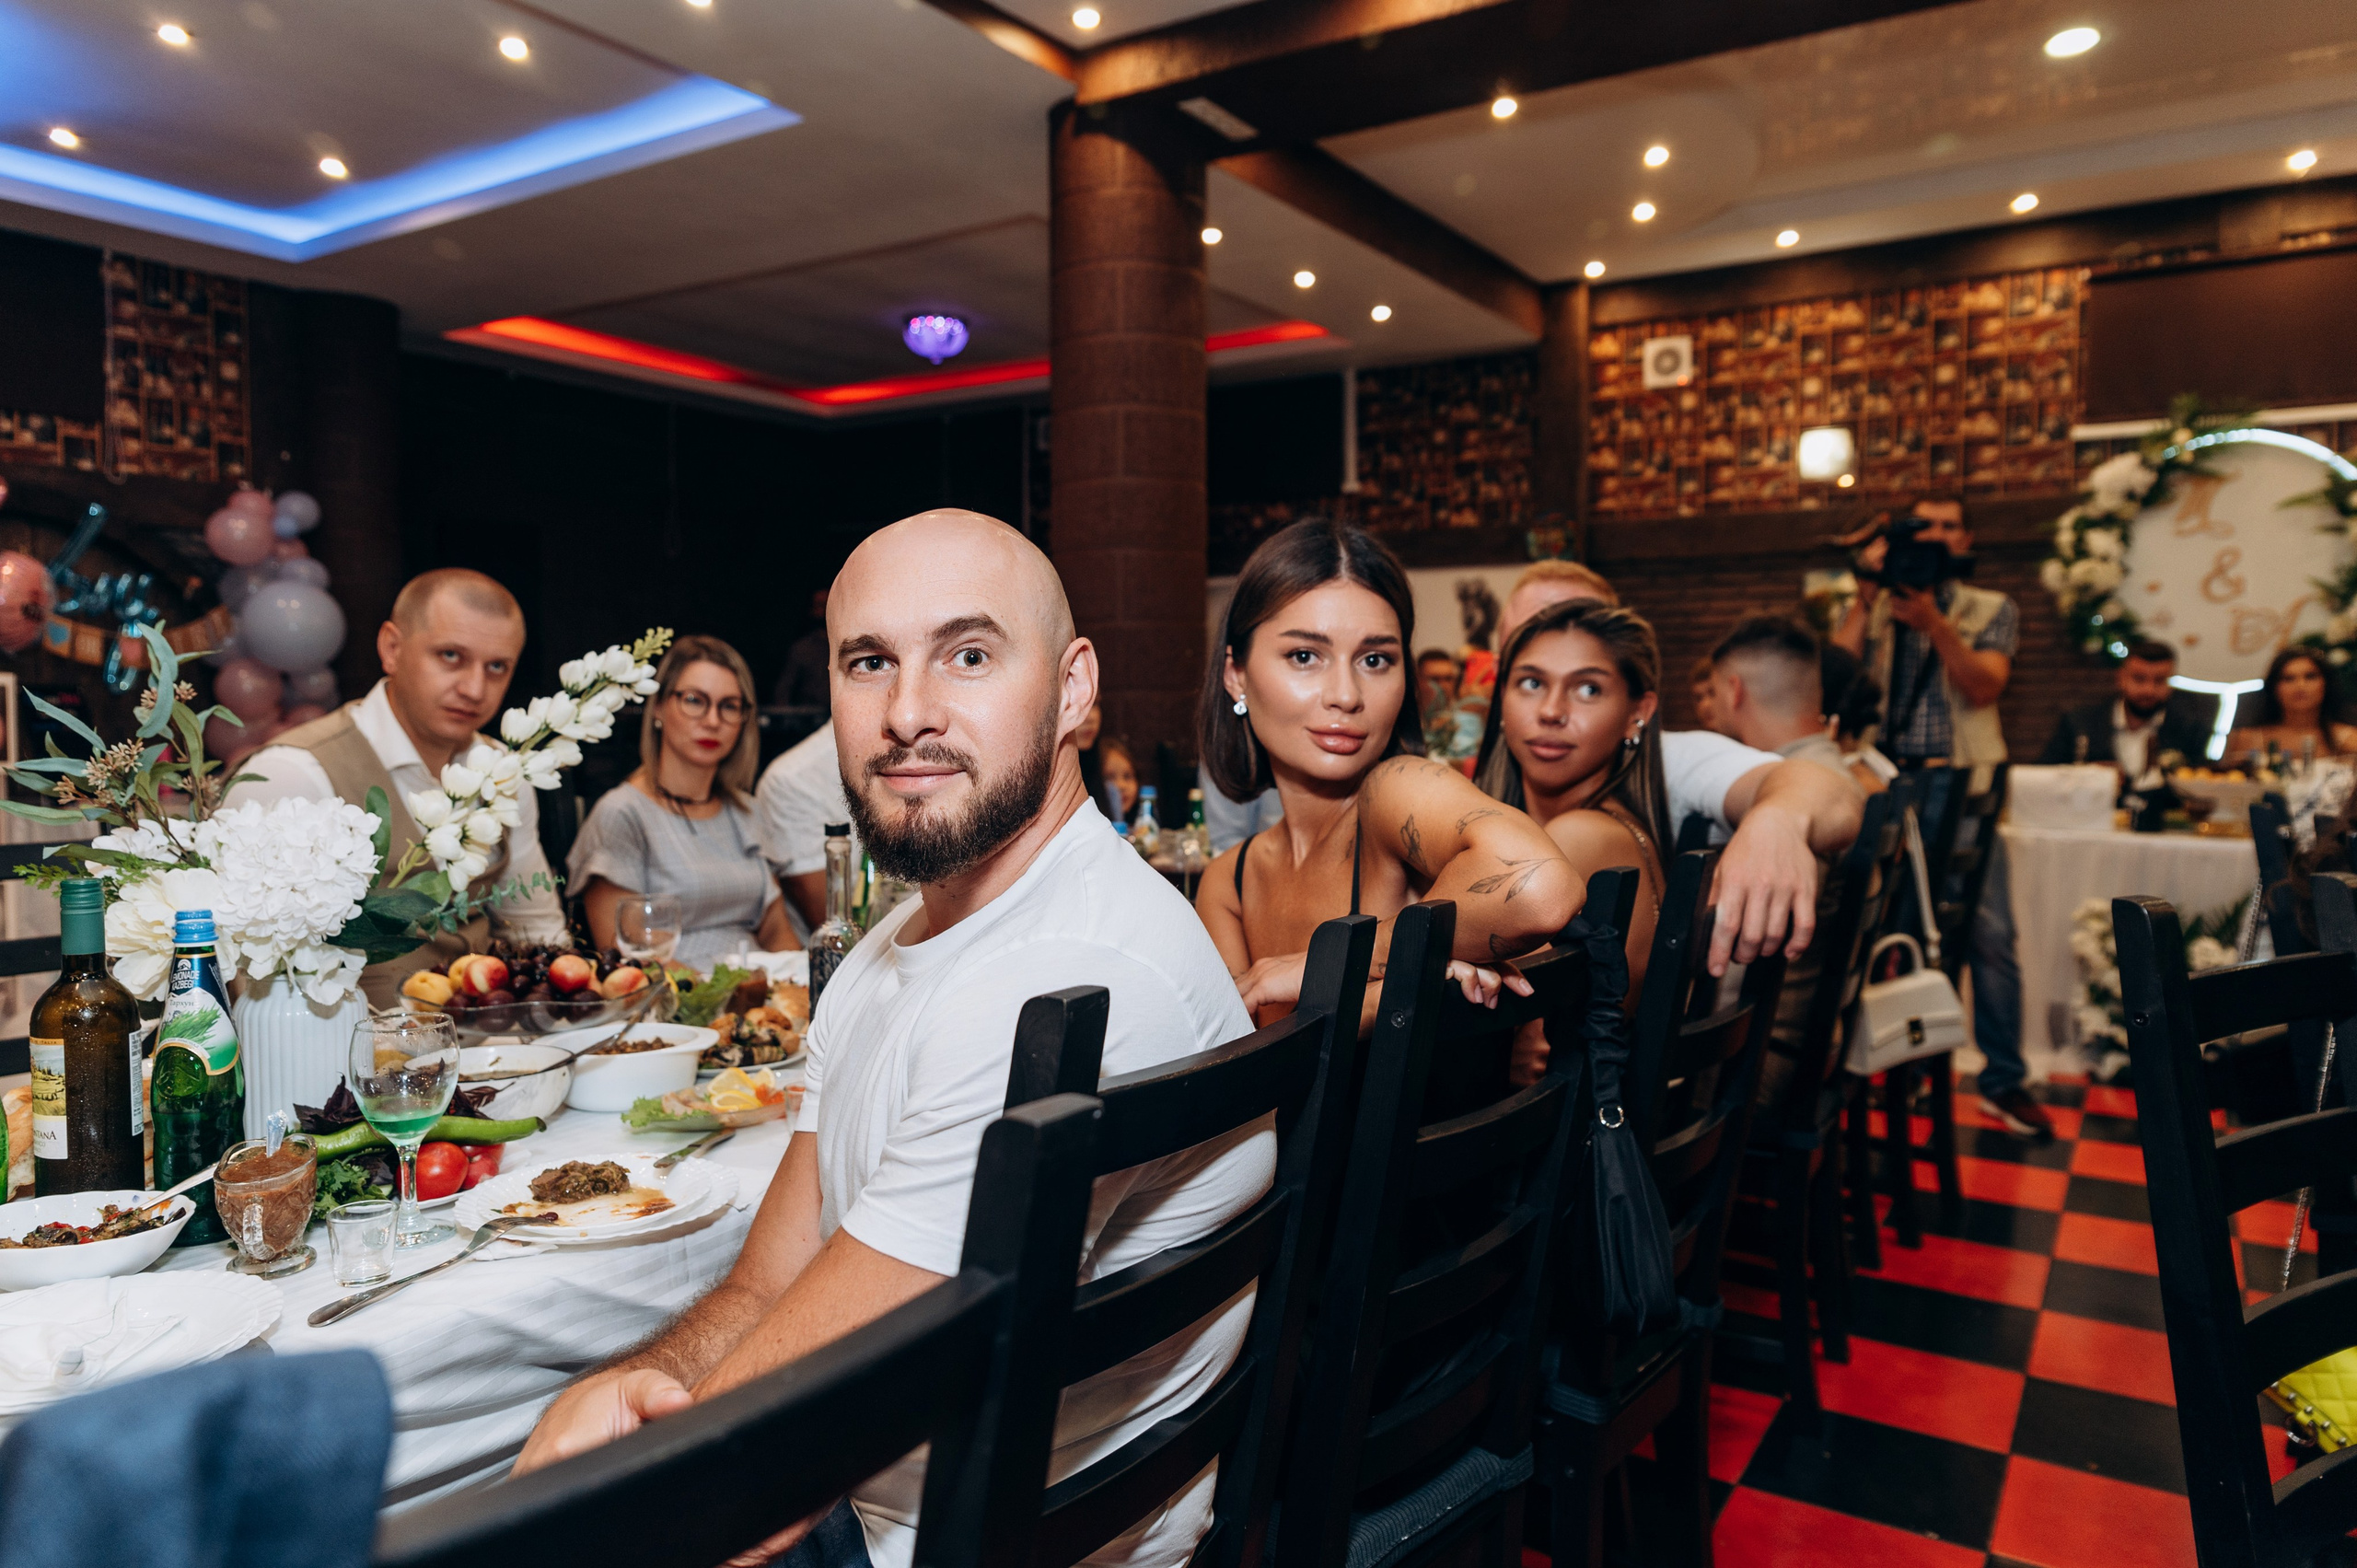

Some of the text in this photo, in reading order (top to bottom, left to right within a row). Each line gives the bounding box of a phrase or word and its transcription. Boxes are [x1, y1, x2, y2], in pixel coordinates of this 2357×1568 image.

[2200, 547, 2247, 604] &
[169, 999, 194, 1008] Тархун
[34, 1130, 57, 1140] NTANA
